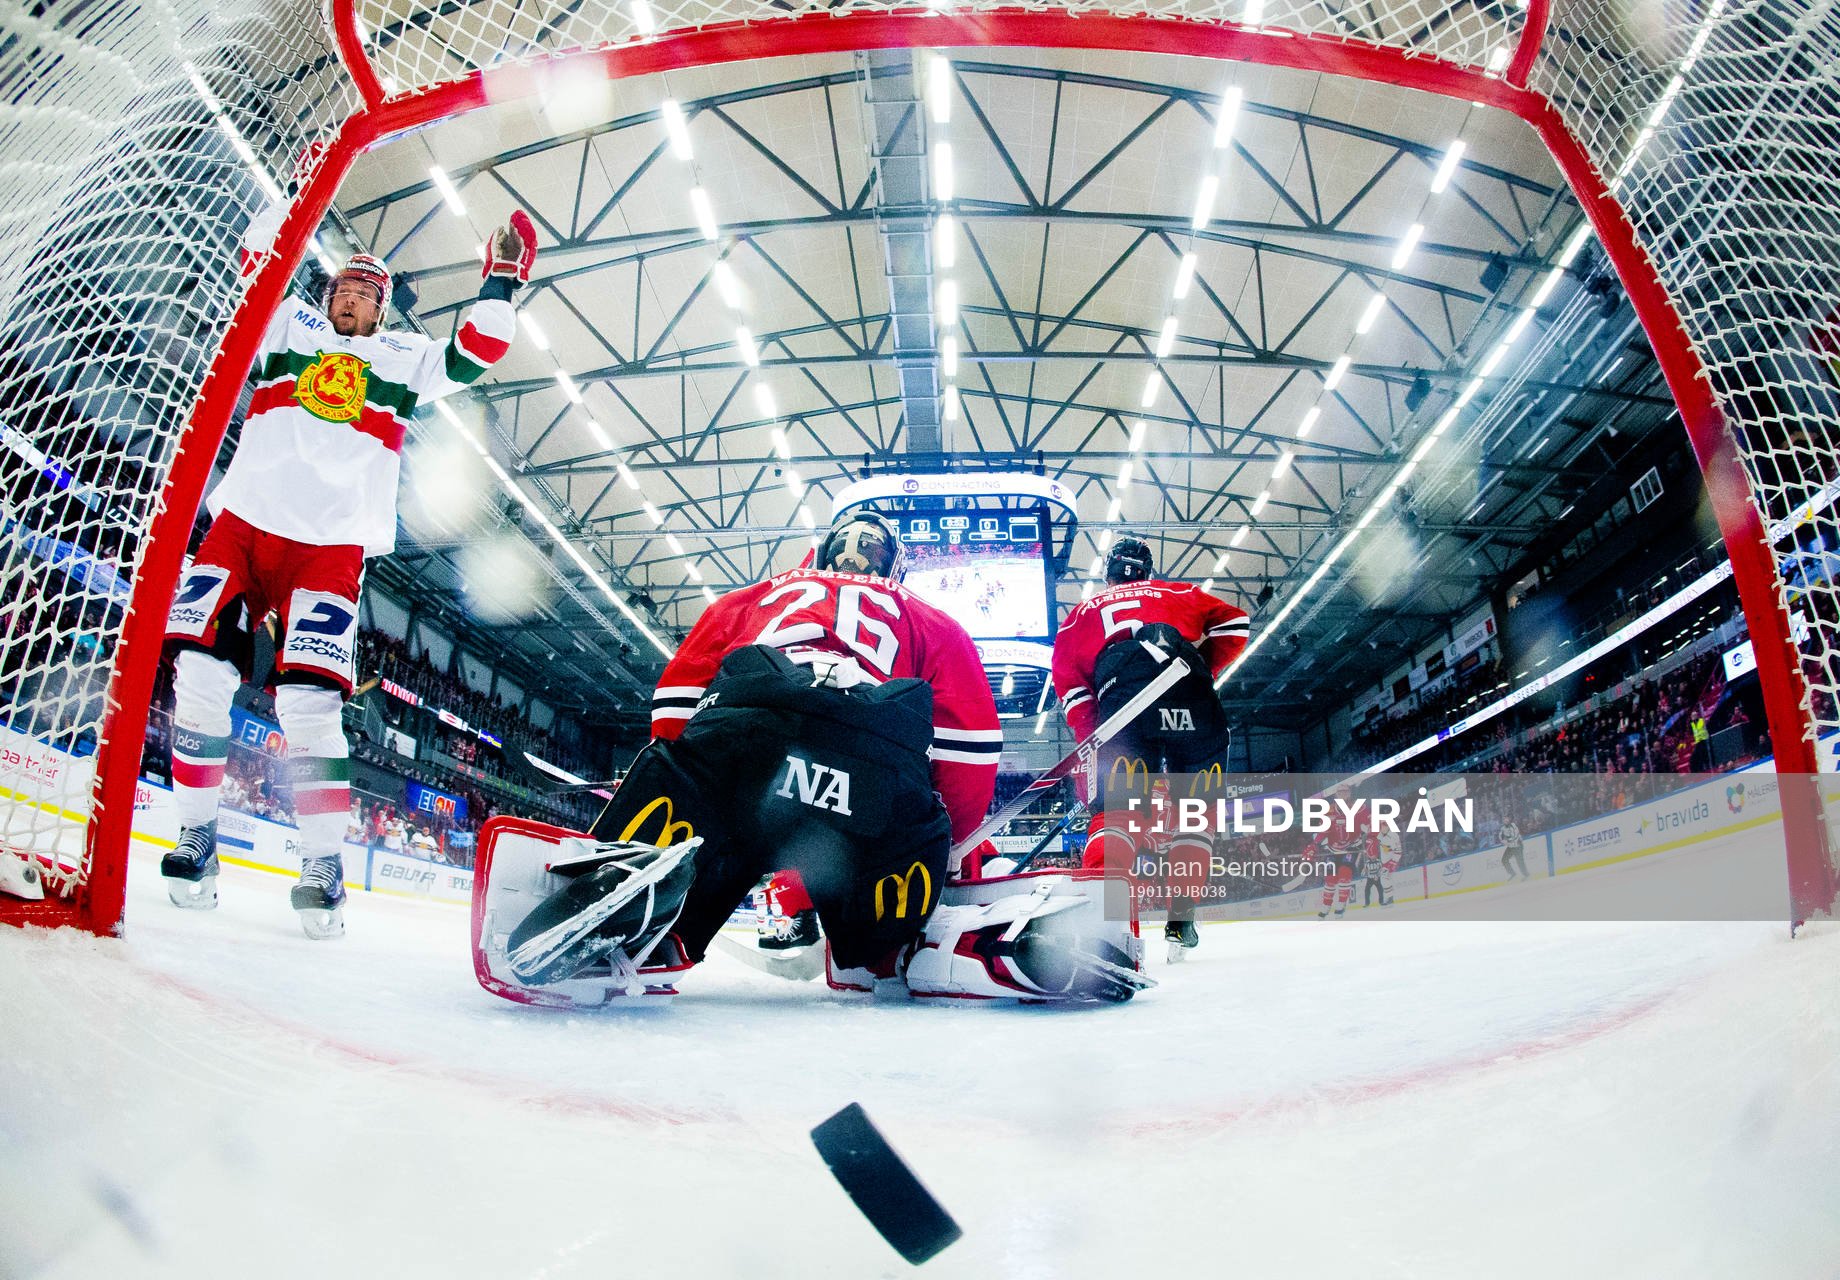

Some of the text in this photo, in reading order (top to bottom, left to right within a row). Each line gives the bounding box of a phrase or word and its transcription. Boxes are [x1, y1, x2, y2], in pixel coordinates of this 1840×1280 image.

[921, 480, 1001, 491] CONTRACTING
[1124, 565, 1132, 576] 5
[752, 580, 901, 677] 26
[1100, 600, 1145, 640] 5
[288, 636, 351, 657] JOHNS
[288, 643, 350, 664] SPORT
[986, 647, 1046, 662] CONTRACT
[1158, 708, 1196, 731] NA
[775, 755, 853, 817] NA
[1238, 784, 1264, 795] Strateg
[1656, 799, 1710, 832] bravida
[1577, 827, 1621, 848] PISCATOR
